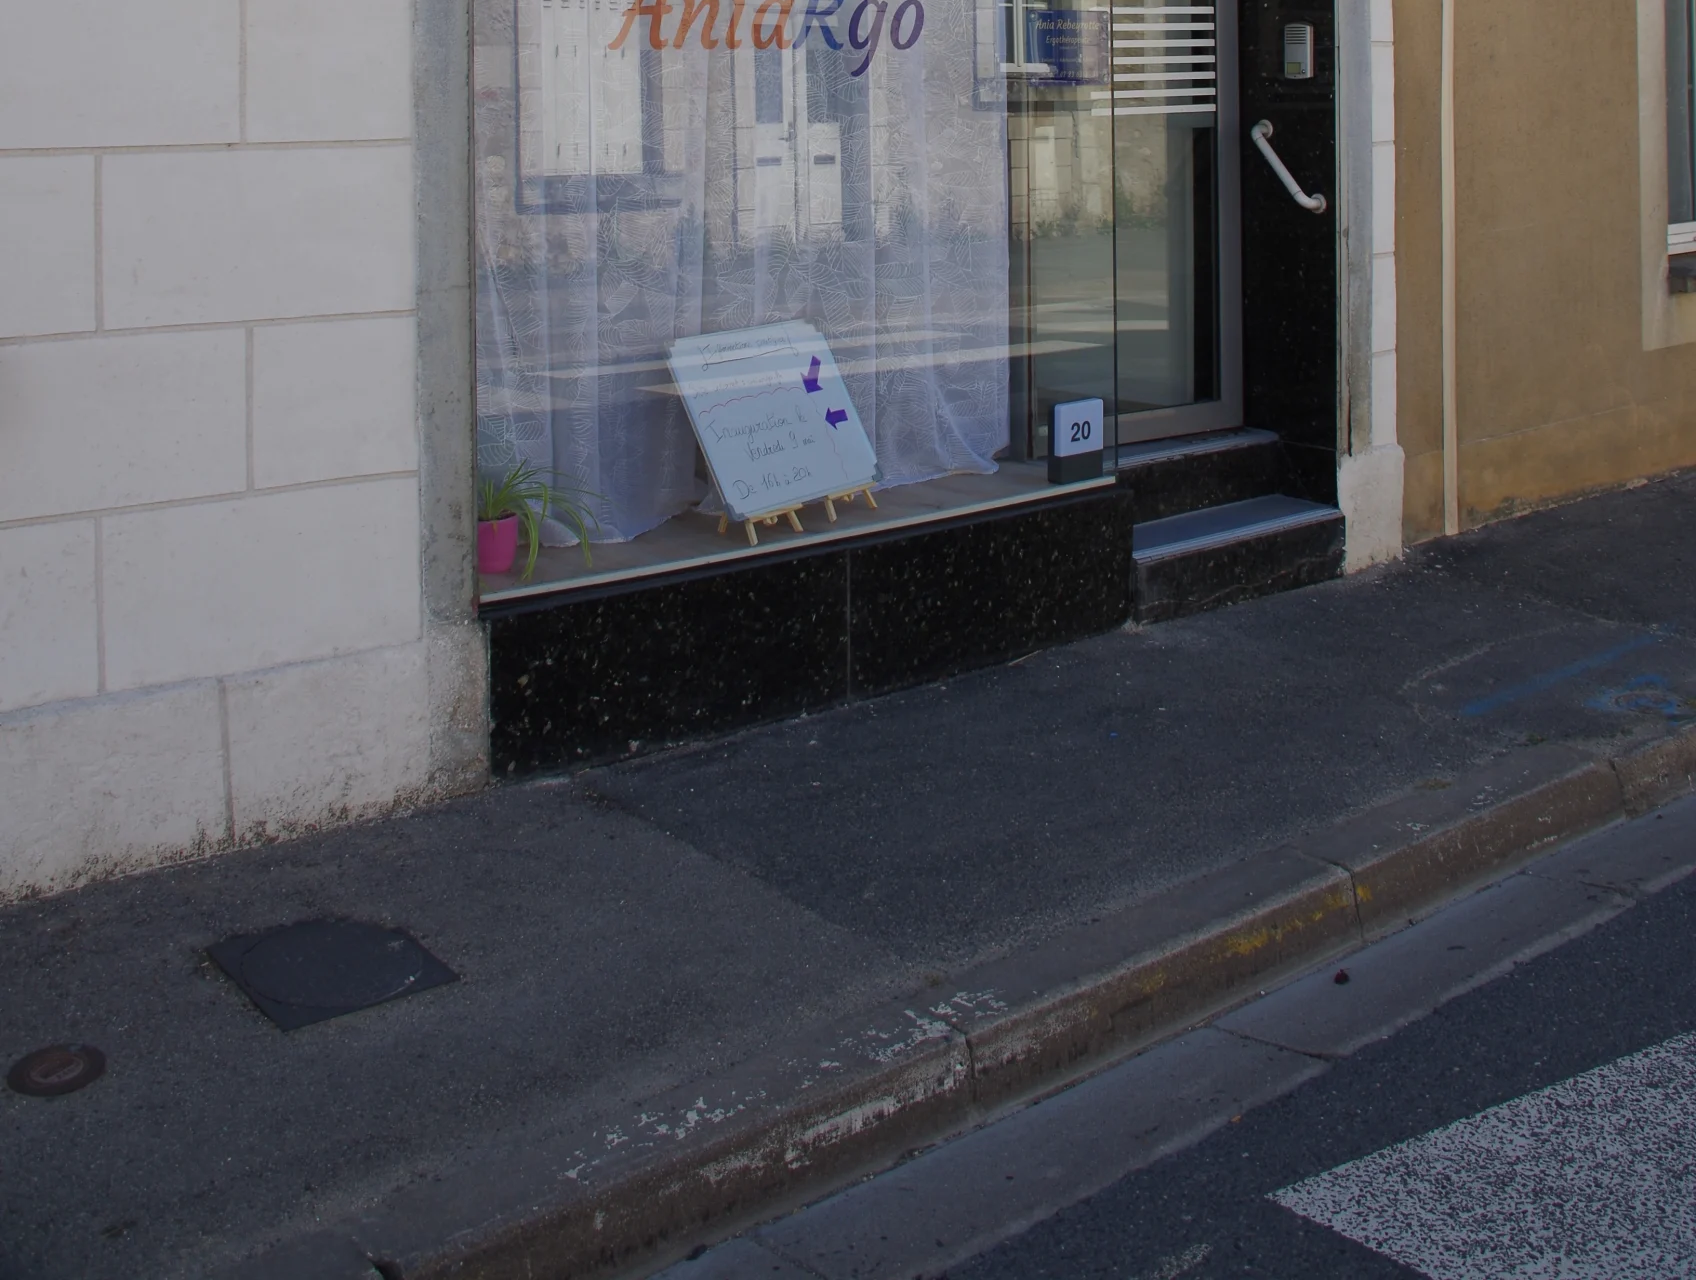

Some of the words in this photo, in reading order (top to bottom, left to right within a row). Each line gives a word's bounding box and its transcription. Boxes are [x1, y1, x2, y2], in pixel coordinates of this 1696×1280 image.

[1035, 18, 1055, 30] Ania
[704, 412, 793, 444] Inauguration
[1070, 420, 1091, 442] 20
[732, 479, 757, 500] De
